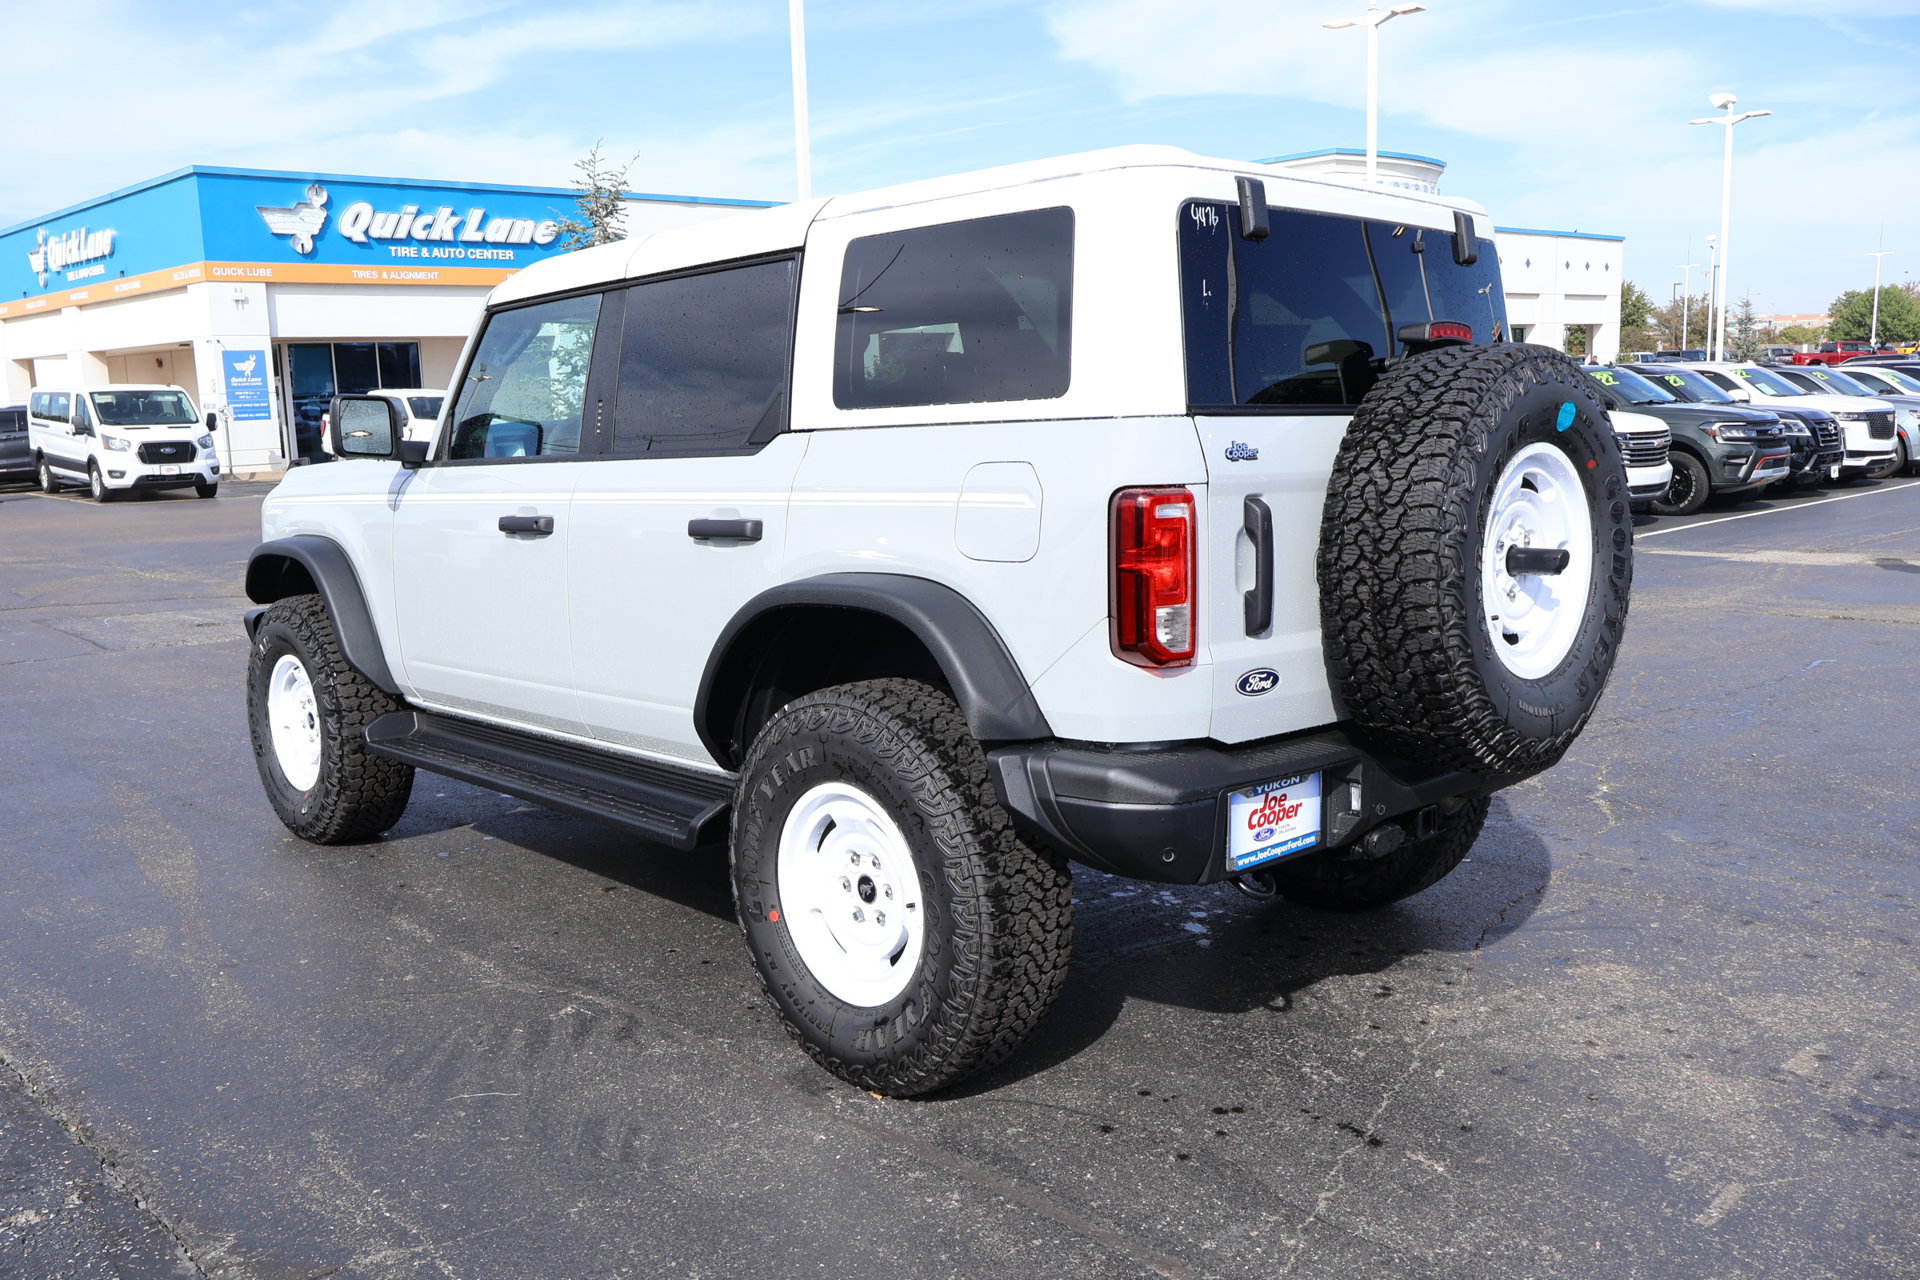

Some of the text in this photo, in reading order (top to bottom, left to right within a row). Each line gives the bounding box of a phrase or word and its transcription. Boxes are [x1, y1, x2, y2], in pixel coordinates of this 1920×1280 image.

[339, 201, 560, 245] Quick Lane
[48, 227, 114, 272] Quick Lane
[389, 246, 515, 260] TIRE & AUTO CENTER
[212, 267, 273, 277] QUICK LUBE
[352, 270, 439, 280] TIRES & ALIGNMENT
[1225, 447, 1259, 460] Cooper
[1231, 440, 1249, 451] Joe
[1245, 672, 1274, 692] Ford
[1256, 776, 1300, 794] YUKON
[1259, 792, 1287, 813] Joe
[1248, 802, 1303, 830] Cooper
[742, 745, 818, 924] GOODYEAR
[1237, 835, 1316, 867] www.JoeCooperFord.com
